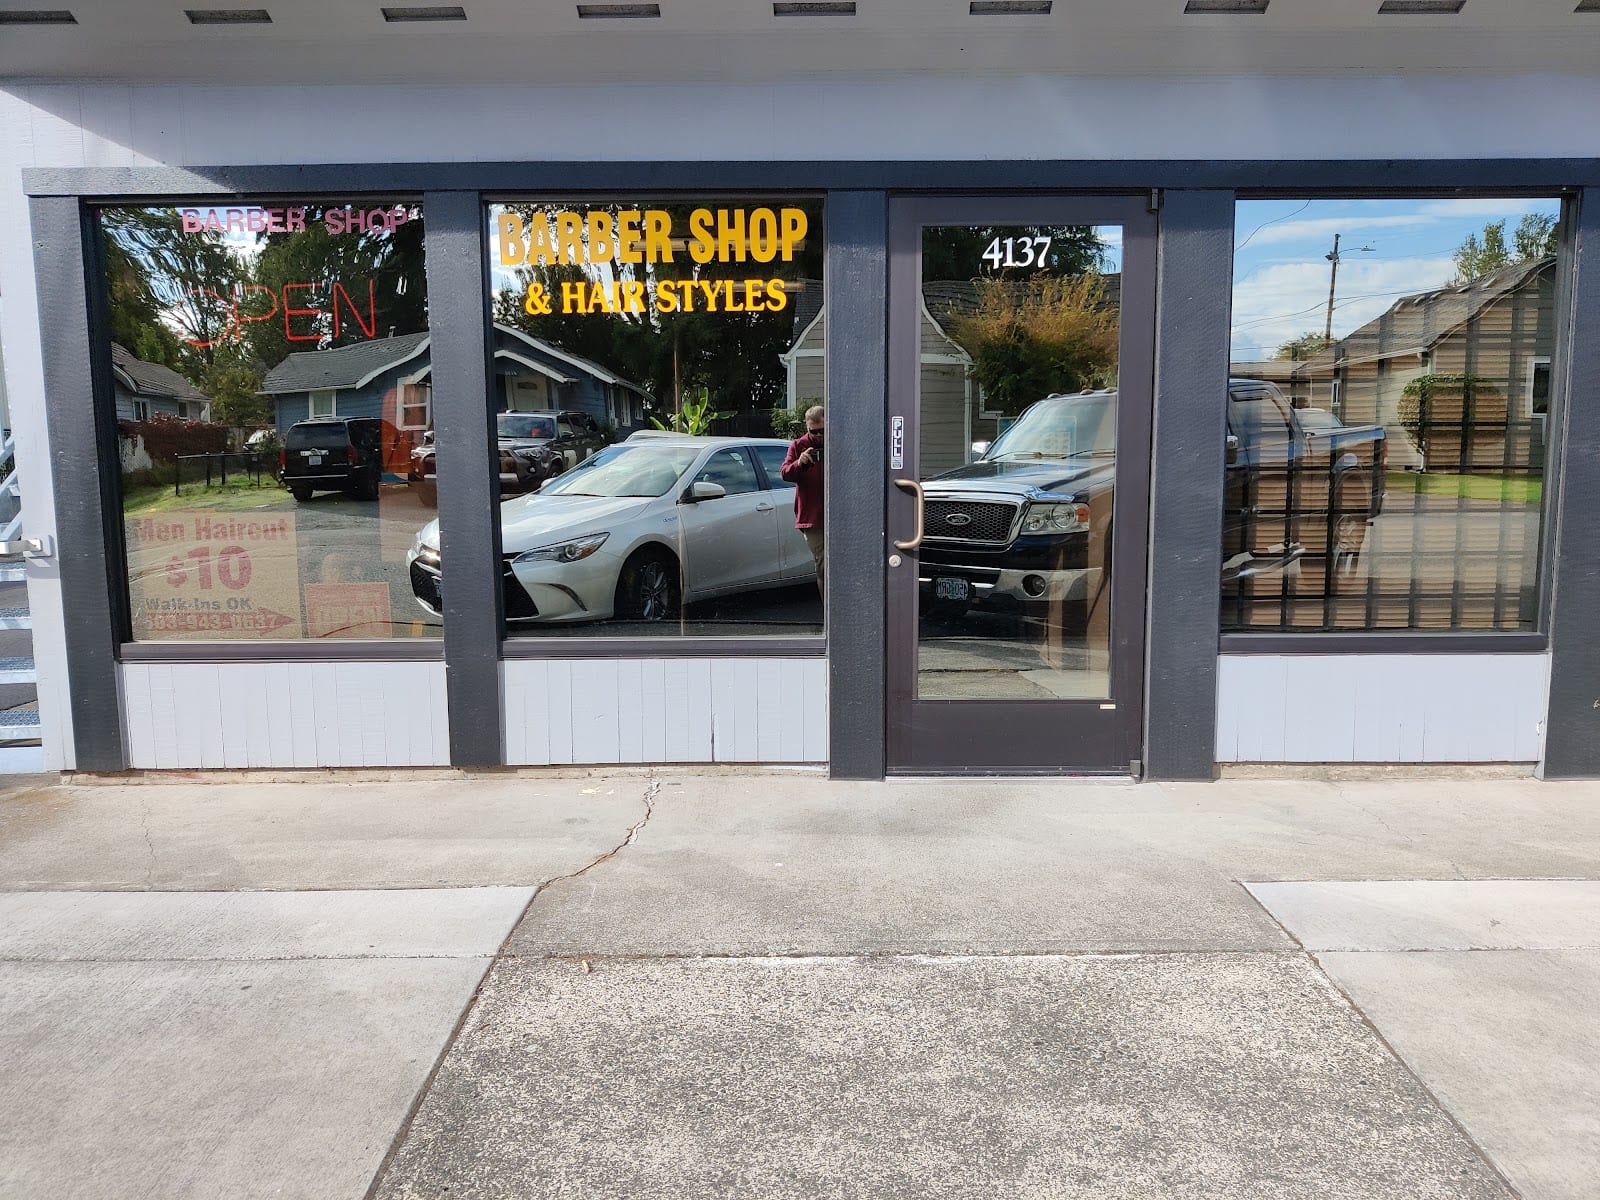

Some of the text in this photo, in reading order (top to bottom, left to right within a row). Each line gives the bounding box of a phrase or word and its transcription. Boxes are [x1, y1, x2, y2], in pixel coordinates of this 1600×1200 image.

[181, 208, 408, 235] BARBER SHOP
[498, 207, 808, 265] BARBER SHOP
[981, 236, 1052, 270] 4137
[177, 279, 376, 348] OPEN
[525, 278, 787, 315] & HAIR STYLES
[893, 420, 902, 457] PULL
[136, 517, 289, 542] Men Haircut
[165, 545, 252, 590] $10
[146, 597, 252, 611] Walk-Ins OK
